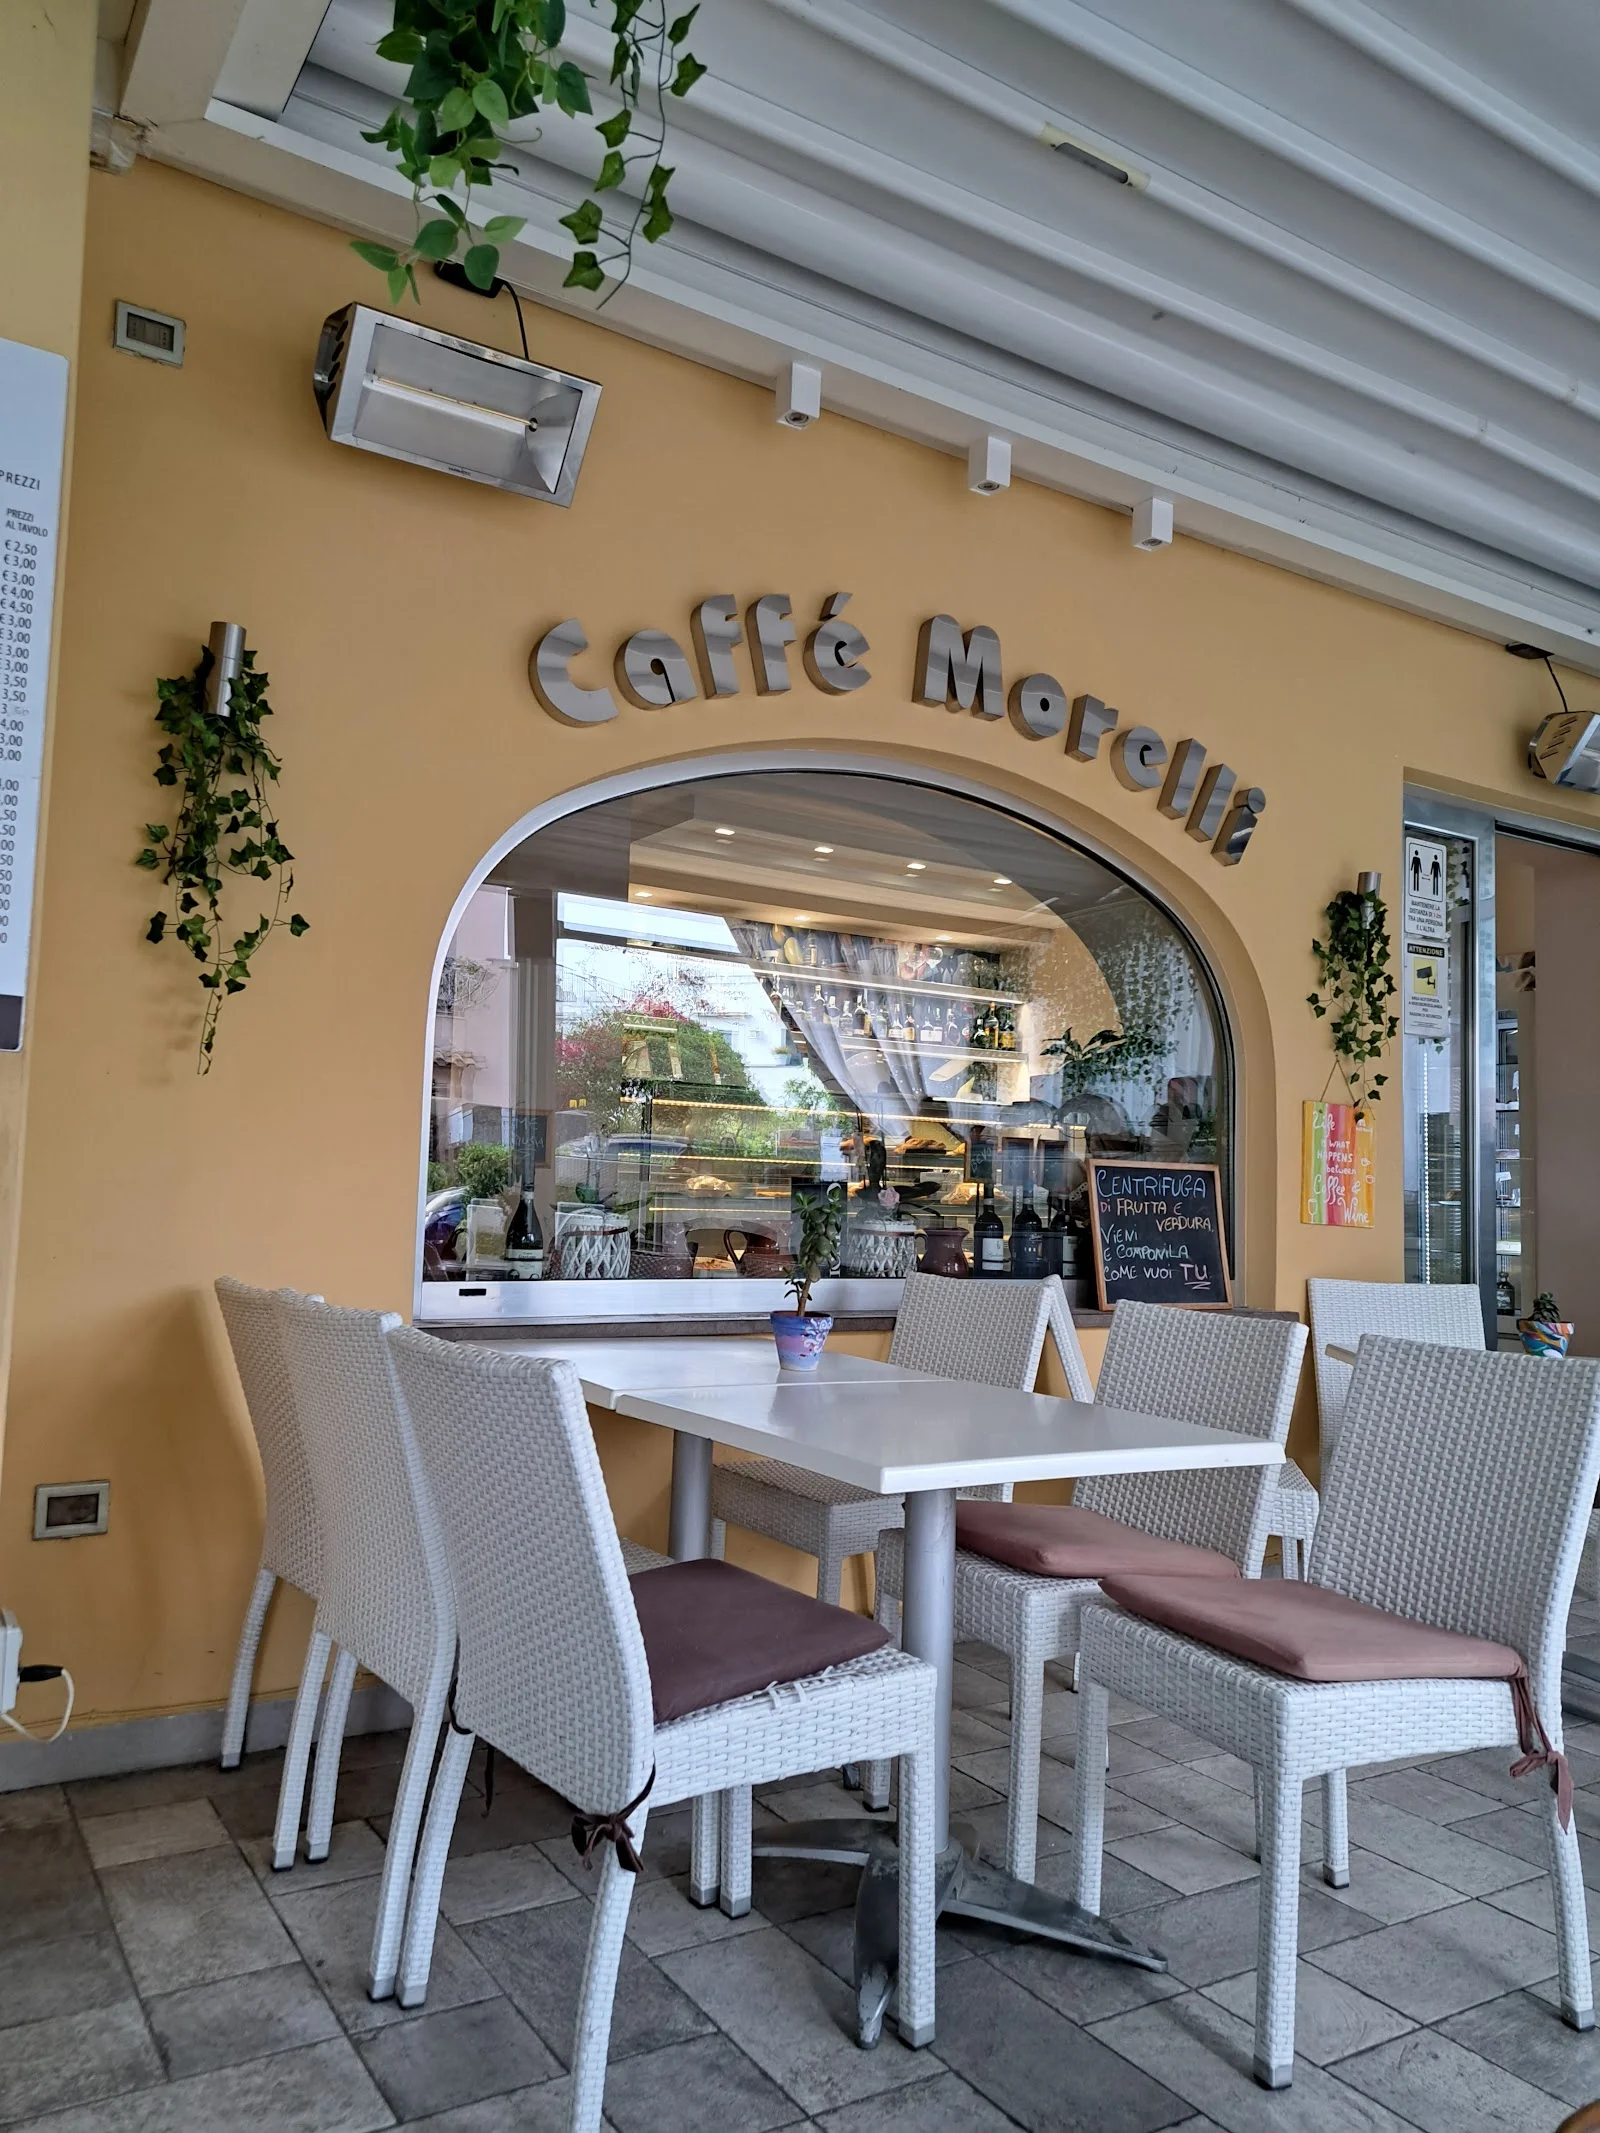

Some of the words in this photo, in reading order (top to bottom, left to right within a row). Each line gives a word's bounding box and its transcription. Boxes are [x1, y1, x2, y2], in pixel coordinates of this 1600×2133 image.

[7, 508, 34, 522] PREZZI
[5, 520, 15, 530] AL
[18, 522, 48, 537] TAVOLO
[528, 591, 873, 728] Caffé
[911, 614, 1267, 867] Morelli
[1408, 946, 1443, 957] ATTENZIONE
[1313, 1111, 1336, 1138] Life
[1329, 1140, 1351, 1149] WHAT
[1317, 1150, 1353, 1163] HAPPENS
[1327, 1164, 1357, 1176] between
[1313, 1174, 1346, 1206] Coffee
[1352, 1180, 1361, 1194] &
[1117, 1198, 1167, 1216] FRUTTA
[1174, 1202, 1183, 1215] E
[1338, 1197, 1369, 1224] Wine
[1104, 1247, 1112, 1261] E
[1104, 1265, 1138, 1282] COME
[1180, 1263, 1208, 1281] TU
